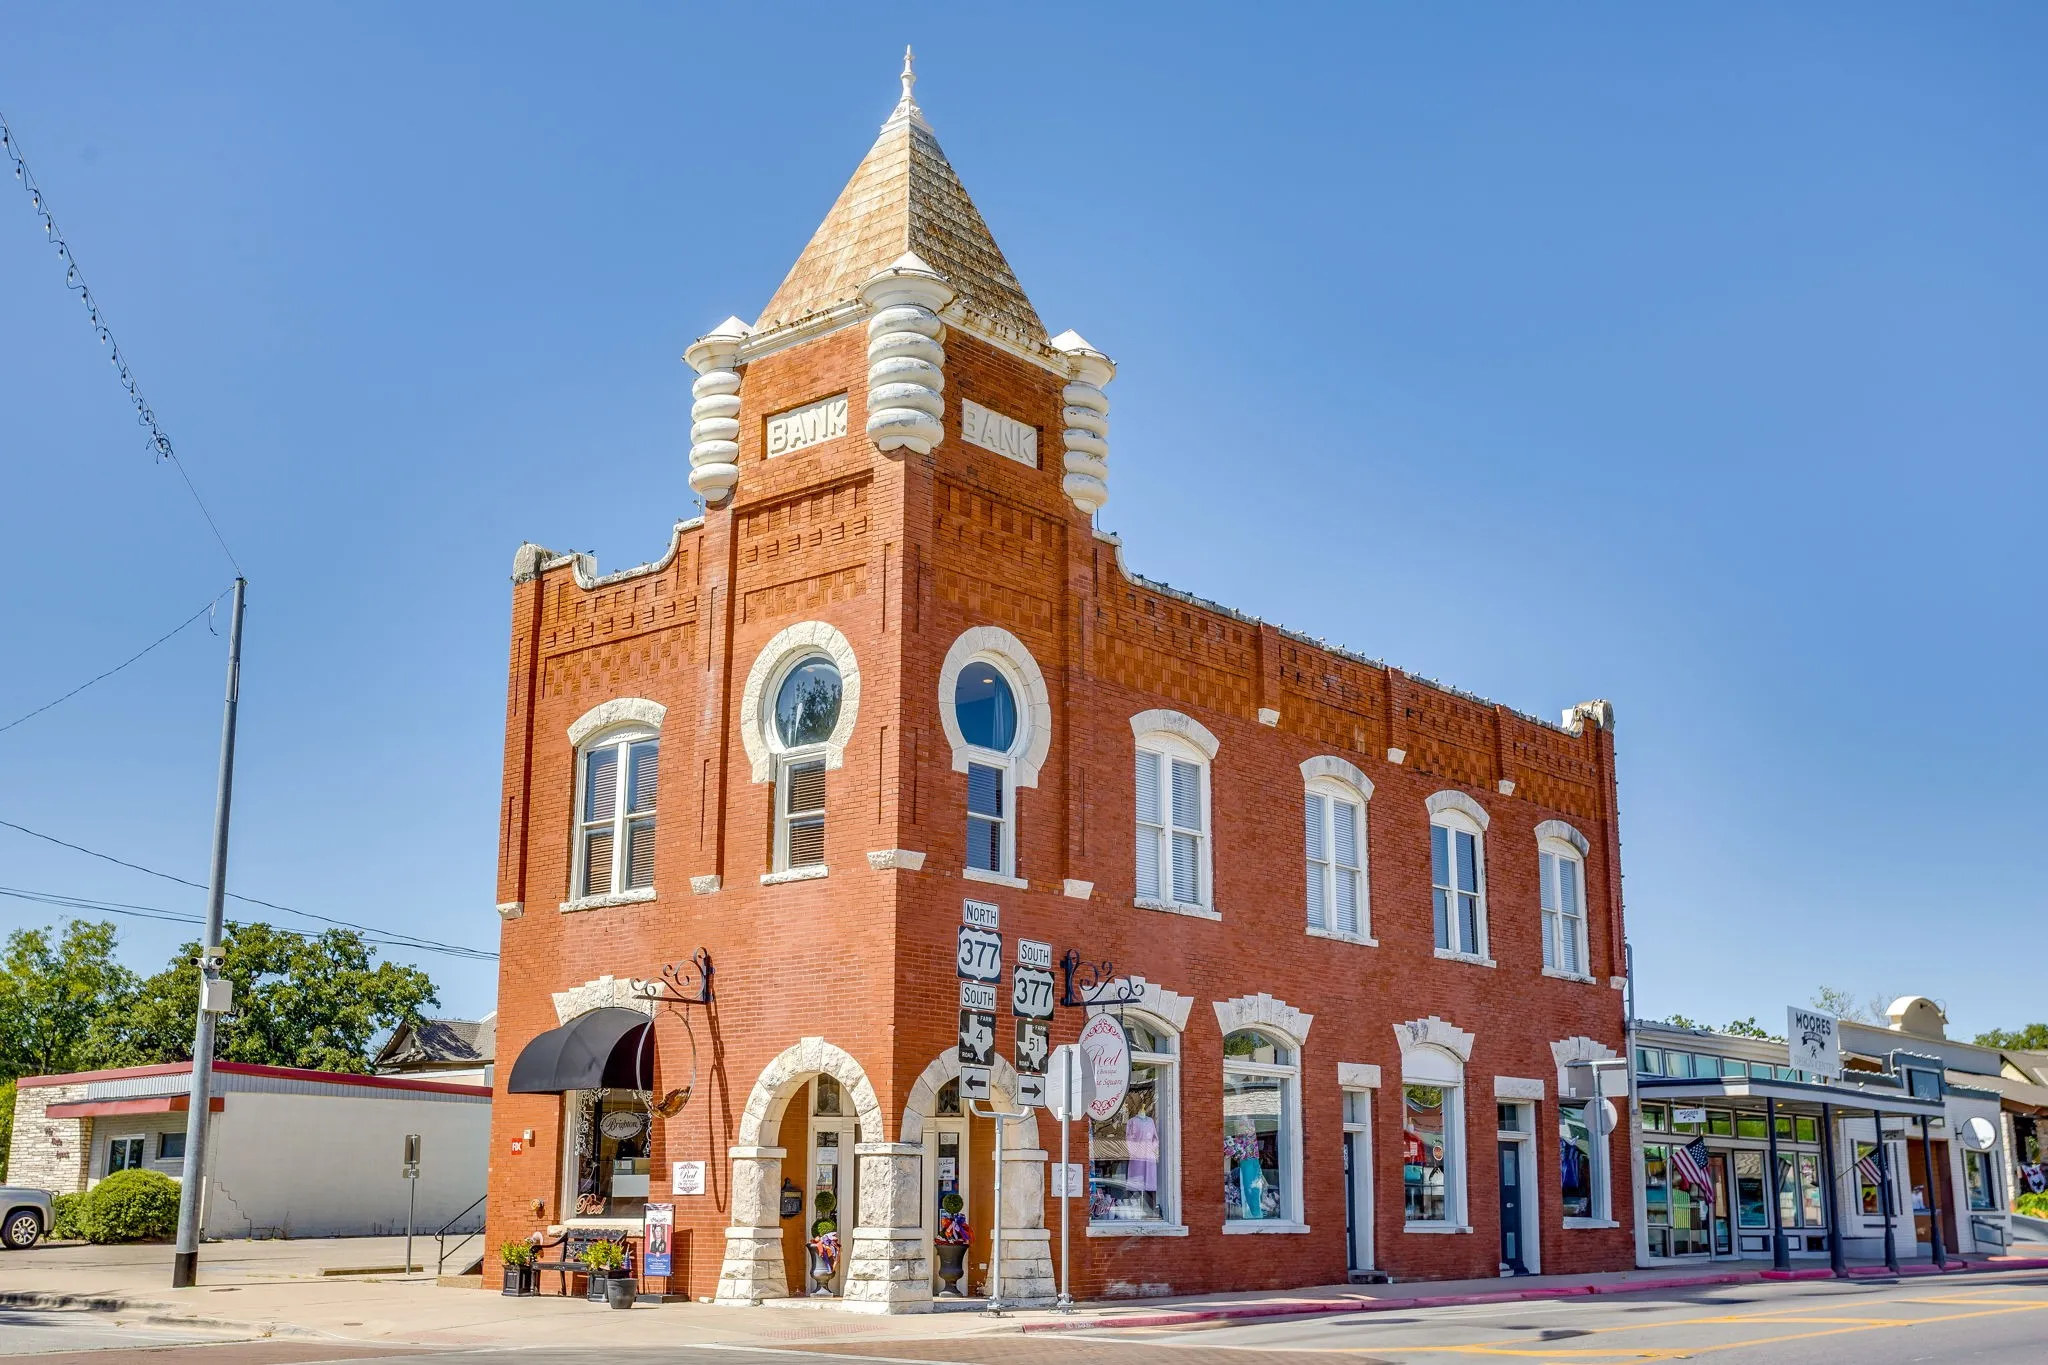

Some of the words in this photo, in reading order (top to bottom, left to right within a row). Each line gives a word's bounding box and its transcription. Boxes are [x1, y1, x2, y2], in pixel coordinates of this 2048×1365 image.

[770, 400, 847, 454] BANK
[963, 402, 1034, 463] BANK
[966, 904, 997, 924] NORTH
[961, 938, 999, 969] 377
[1021, 944, 1049, 963] SOUTH
[963, 987, 994, 1006] SOUTH
[1016, 978, 1052, 1007] 377
[1796, 1012, 1831, 1036] MOORES
[976, 1029, 983, 1043] 4
[1029, 1038, 1039, 1052] 51
[1086, 1043, 1122, 1066] Red
[1103, 1078, 1122, 1088] Square
[606, 1118, 638, 1131] Brighton
[680, 1169, 698, 1179] Red
[575, 1193, 606, 1215] Red
